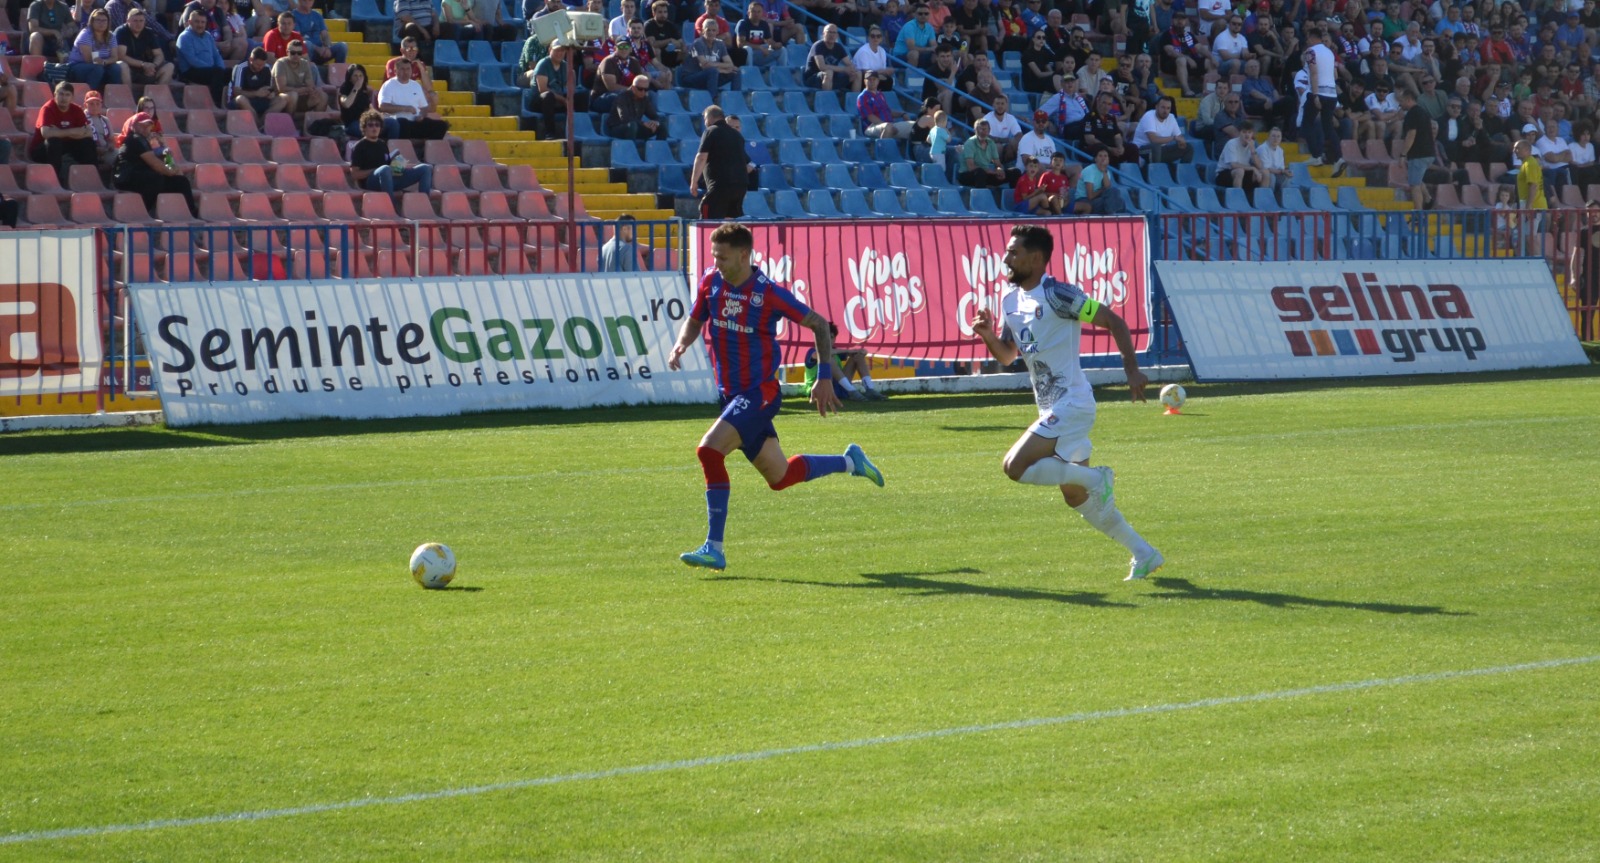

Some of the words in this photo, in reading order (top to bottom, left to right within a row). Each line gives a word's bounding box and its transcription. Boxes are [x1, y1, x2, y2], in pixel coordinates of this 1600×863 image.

[750, 248, 792, 283] va
[847, 246, 907, 291] Viva
[1063, 242, 1114, 285] Viva
[844, 275, 923, 339] Chips
[1077, 270, 1128, 307] ips
[1271, 272, 1475, 323] selina
[712, 318, 754, 333] selina
[722, 305, 743, 317] Chips
[956, 280, 1008, 338] Chi
[1381, 326, 1487, 363] grup
[178, 376, 363, 396] Produse
[396, 362, 651, 393] profesionale
[735, 397, 751, 410] 25
